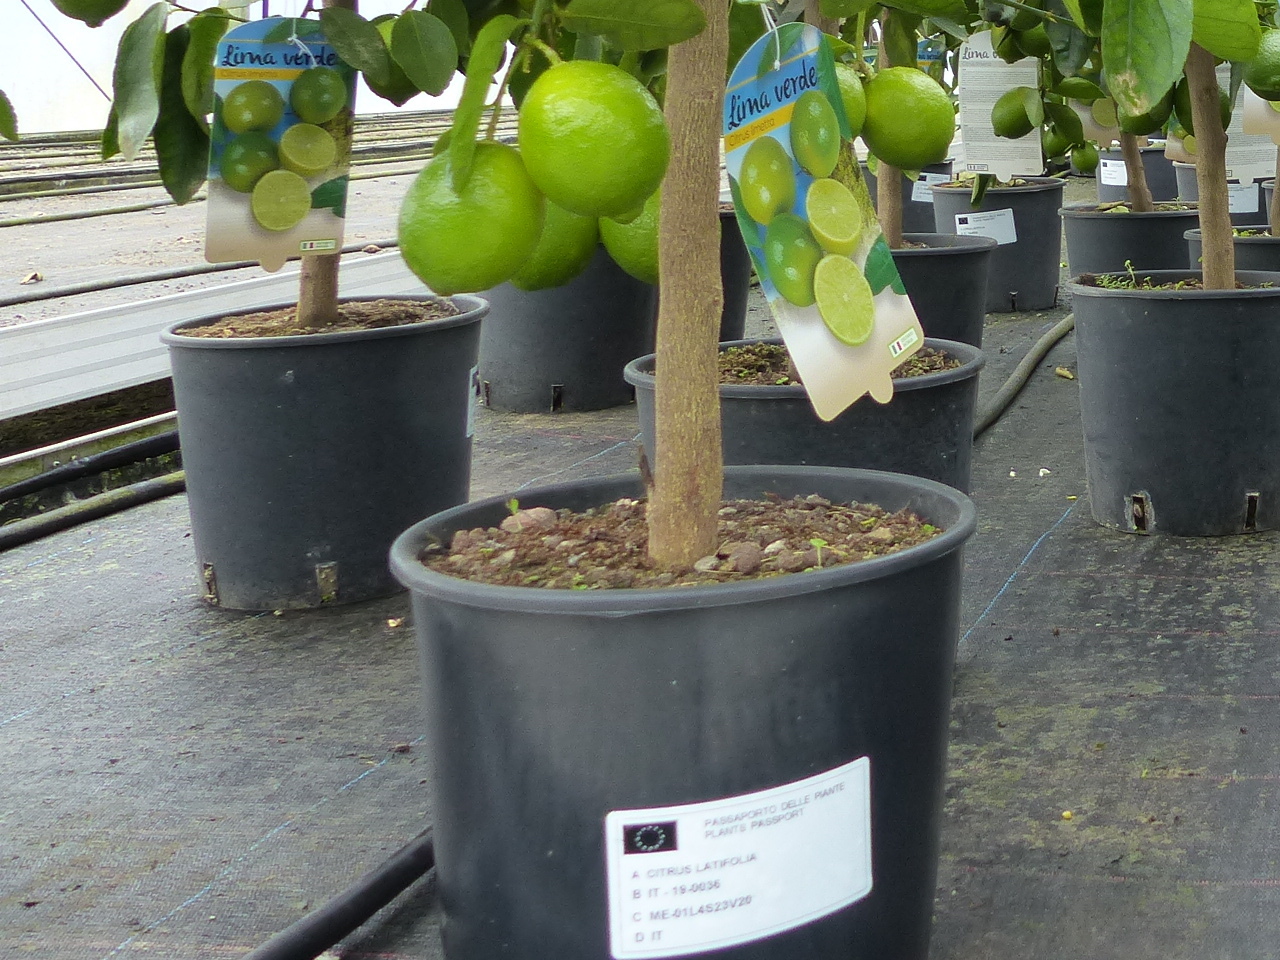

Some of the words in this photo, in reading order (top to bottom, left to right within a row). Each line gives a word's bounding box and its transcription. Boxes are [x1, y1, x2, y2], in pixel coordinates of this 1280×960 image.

[222, 44, 277, 67] Lima
[283, 46, 336, 66] verde
[962, 46, 989, 60] Lima
[728, 91, 771, 131] Lima
[774, 59, 818, 102] verde
[704, 804, 777, 827] PASSAPORTO
[780, 794, 811, 811] DELLE
[814, 782, 845, 800] PIANTE
[751, 808, 804, 829] PASSPORT
[632, 871, 640, 879] A
[647, 865, 692, 878] CITRUS
[696, 853, 757, 873] LATIFOLIA
[633, 889, 641, 899] B
[648, 887, 660, 898] IT
[632, 911, 642, 922] C
[635, 932, 645, 942] D
[651, 930, 663, 941] IT
